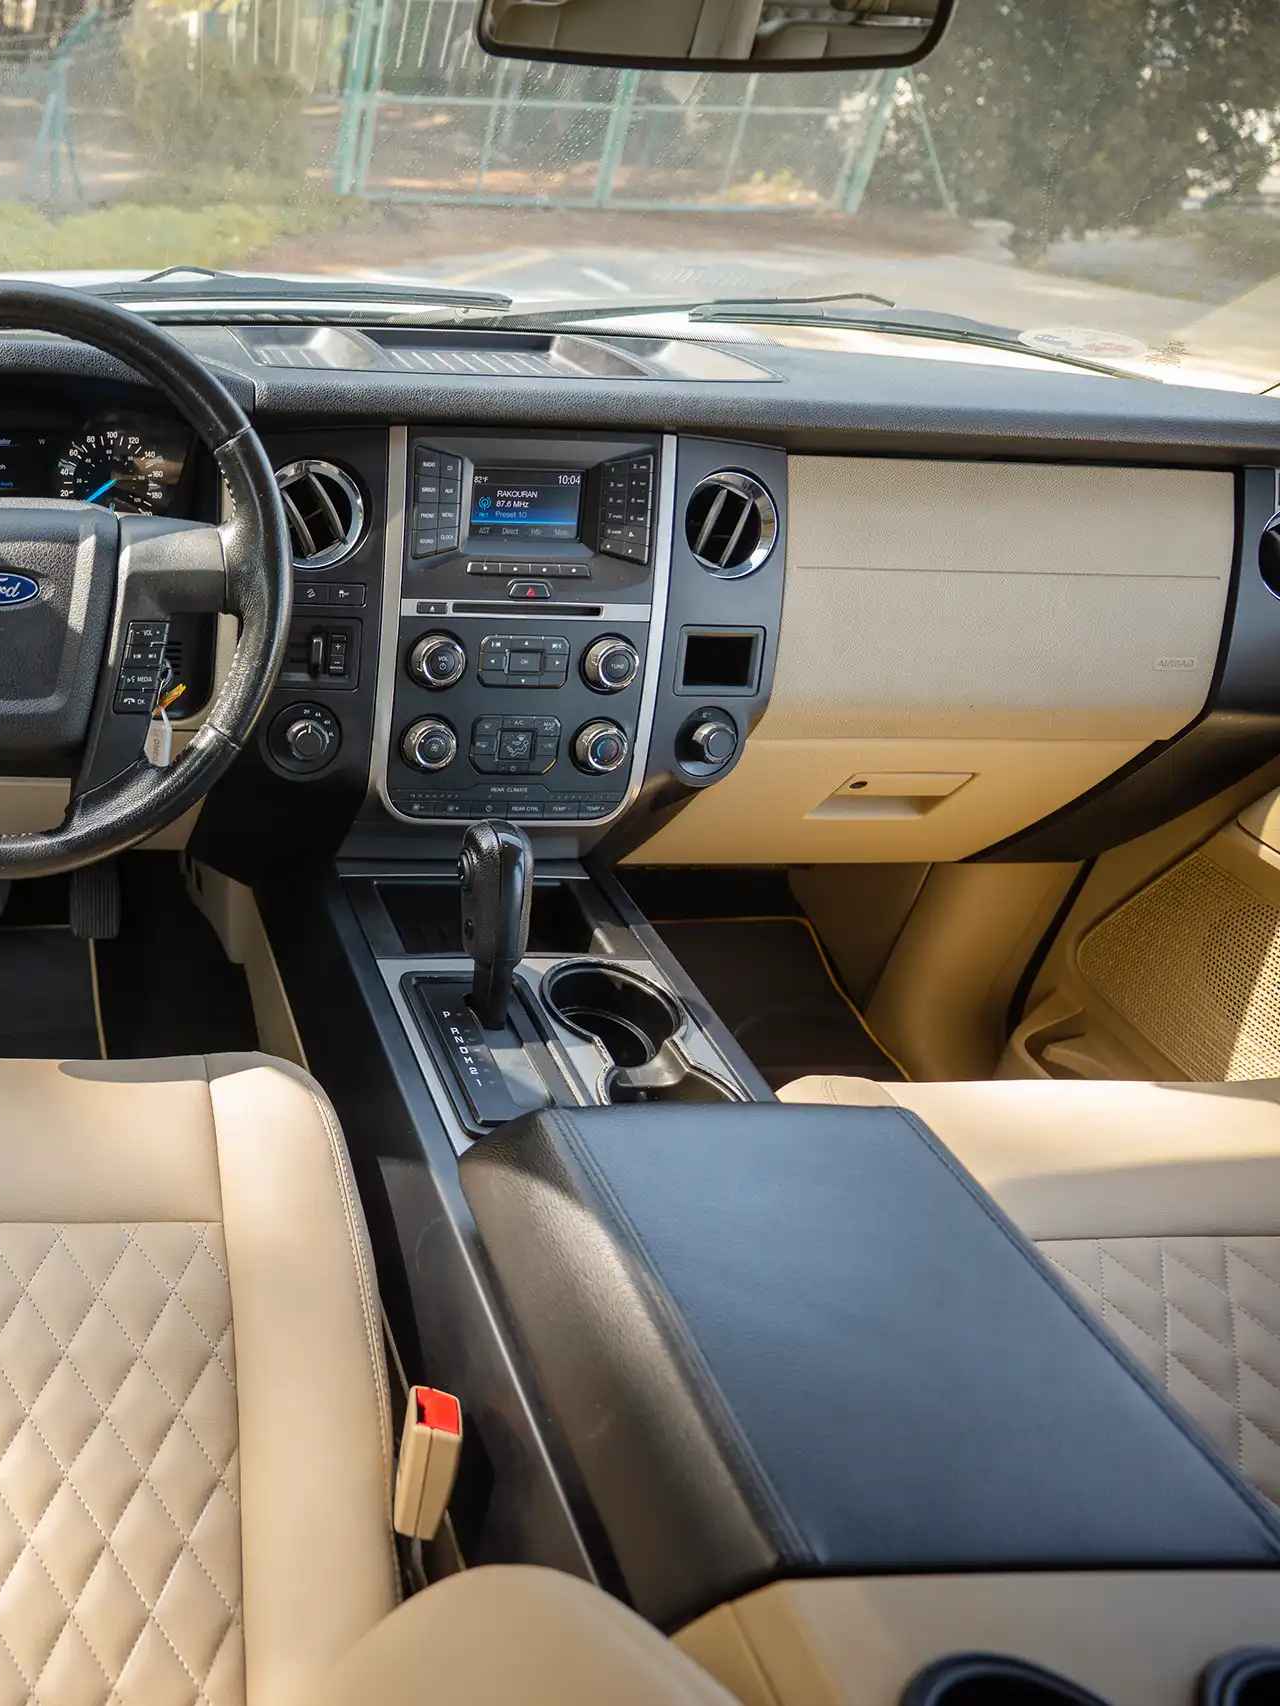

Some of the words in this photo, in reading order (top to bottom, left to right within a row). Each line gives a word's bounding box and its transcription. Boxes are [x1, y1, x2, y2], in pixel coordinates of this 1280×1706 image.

[86, 435, 95, 443] 80
[106, 431, 117, 439] 100
[60, 468, 68, 476] 40
[558, 475, 581, 485] 10:04
[495, 500, 512, 508] 87.6
[512, 500, 529, 508] MHz
[495, 511, 517, 519] Preset
[502, 527, 519, 535] Direct
[442, 1010, 451, 1018] P
[450, 1027, 460, 1035] R
[459, 1046, 468, 1054] D
[469, 1067, 479, 1075] 2
[476, 1079, 482, 1087] 1
